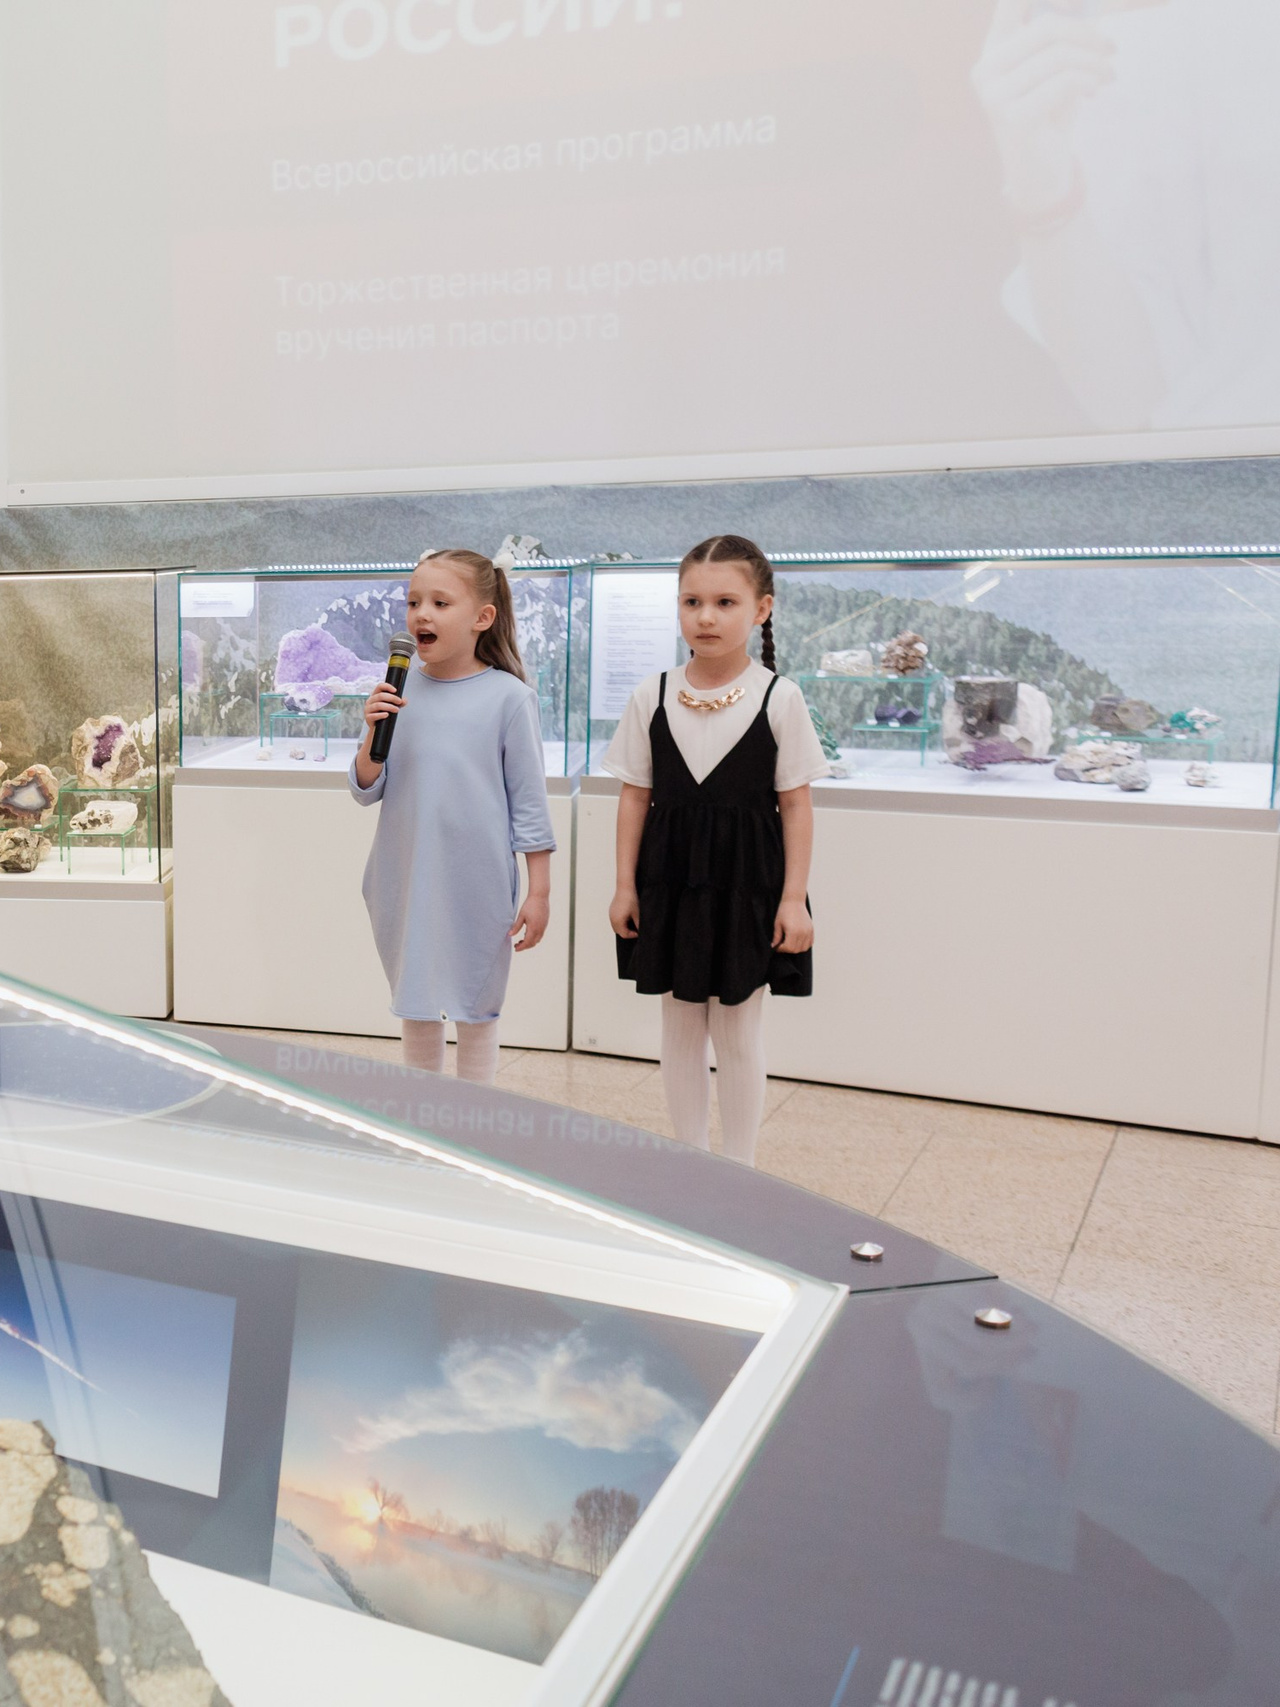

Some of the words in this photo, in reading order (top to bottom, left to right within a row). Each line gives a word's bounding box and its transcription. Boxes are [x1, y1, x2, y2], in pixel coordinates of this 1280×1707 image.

[271, 141, 543, 196] Всероссийская
[555, 113, 778, 173] программа
[275, 264, 553, 313] Торжественная
[565, 245, 787, 298] церемония
[275, 320, 437, 362] вручения
[447, 311, 622, 351] паспорта
